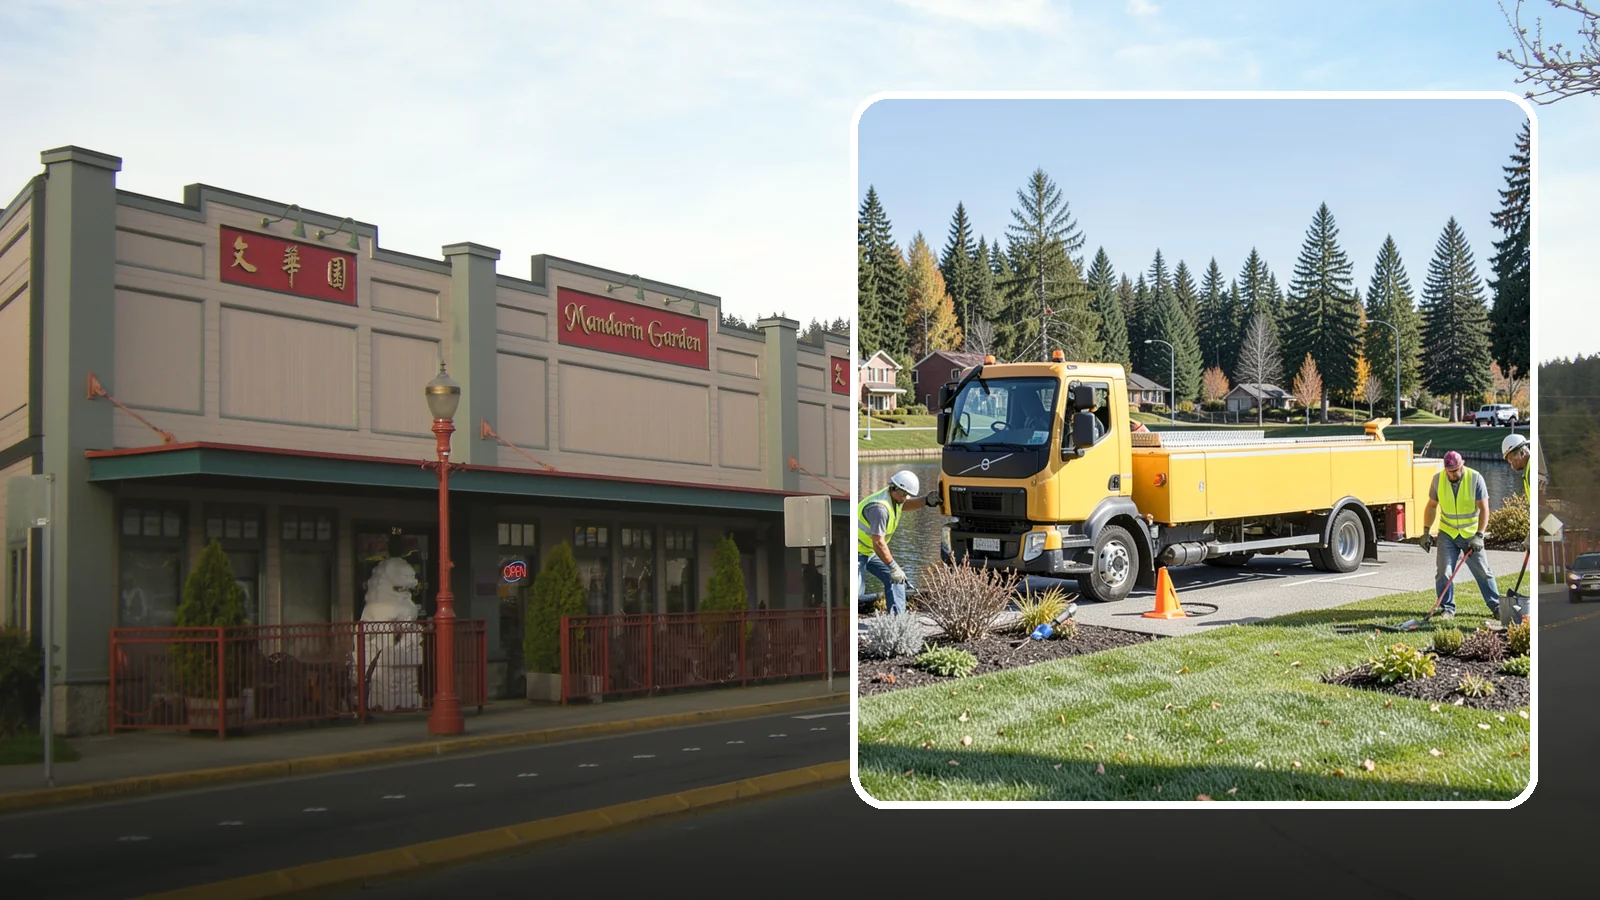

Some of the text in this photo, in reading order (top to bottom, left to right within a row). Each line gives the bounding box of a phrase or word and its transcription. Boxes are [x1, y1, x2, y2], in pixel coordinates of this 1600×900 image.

[564, 302, 702, 352] Mandarin Garden
[503, 565, 527, 578] OPEN
